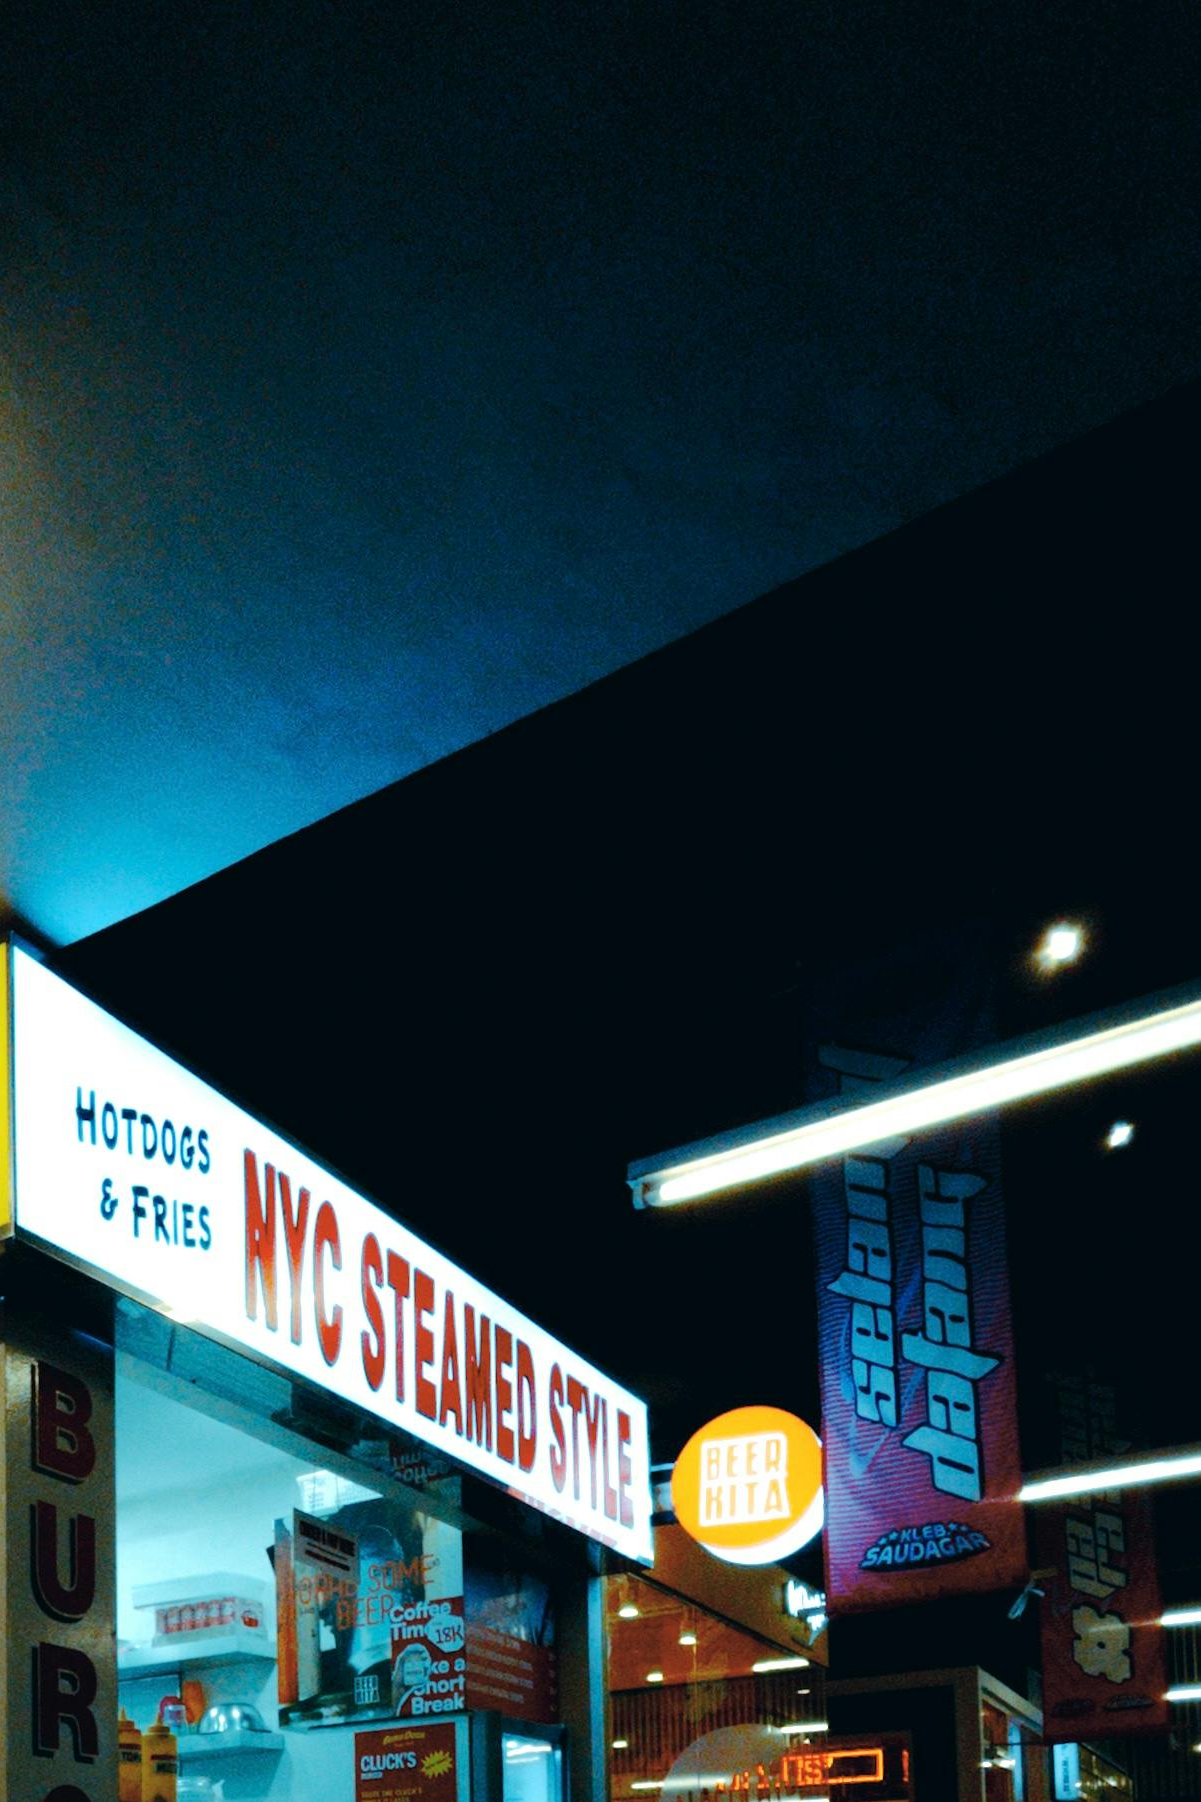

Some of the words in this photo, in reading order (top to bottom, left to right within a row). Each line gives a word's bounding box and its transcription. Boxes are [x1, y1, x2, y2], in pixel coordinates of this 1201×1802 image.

[76, 1086, 211, 1174] HOTDOGS
[100, 1178, 118, 1220] &
[132, 1185, 212, 1251] FRIES
[243, 1146, 343, 1367] NYC
[361, 1232, 537, 1474] STEAMED
[548, 1361, 635, 1530] STYLE
[706, 1438, 782, 1481] BEER
[705, 1478, 784, 1521] KITA
[860, 1531, 991, 1568] SAUDAGAR
[367, 1554, 436, 1593] SOME
[389, 1600, 452, 1623] Coffee
[390, 1622, 424, 1641] Tim
[410, 1691, 466, 1715] Break
[360, 1751, 417, 1772] CLUCK'S
